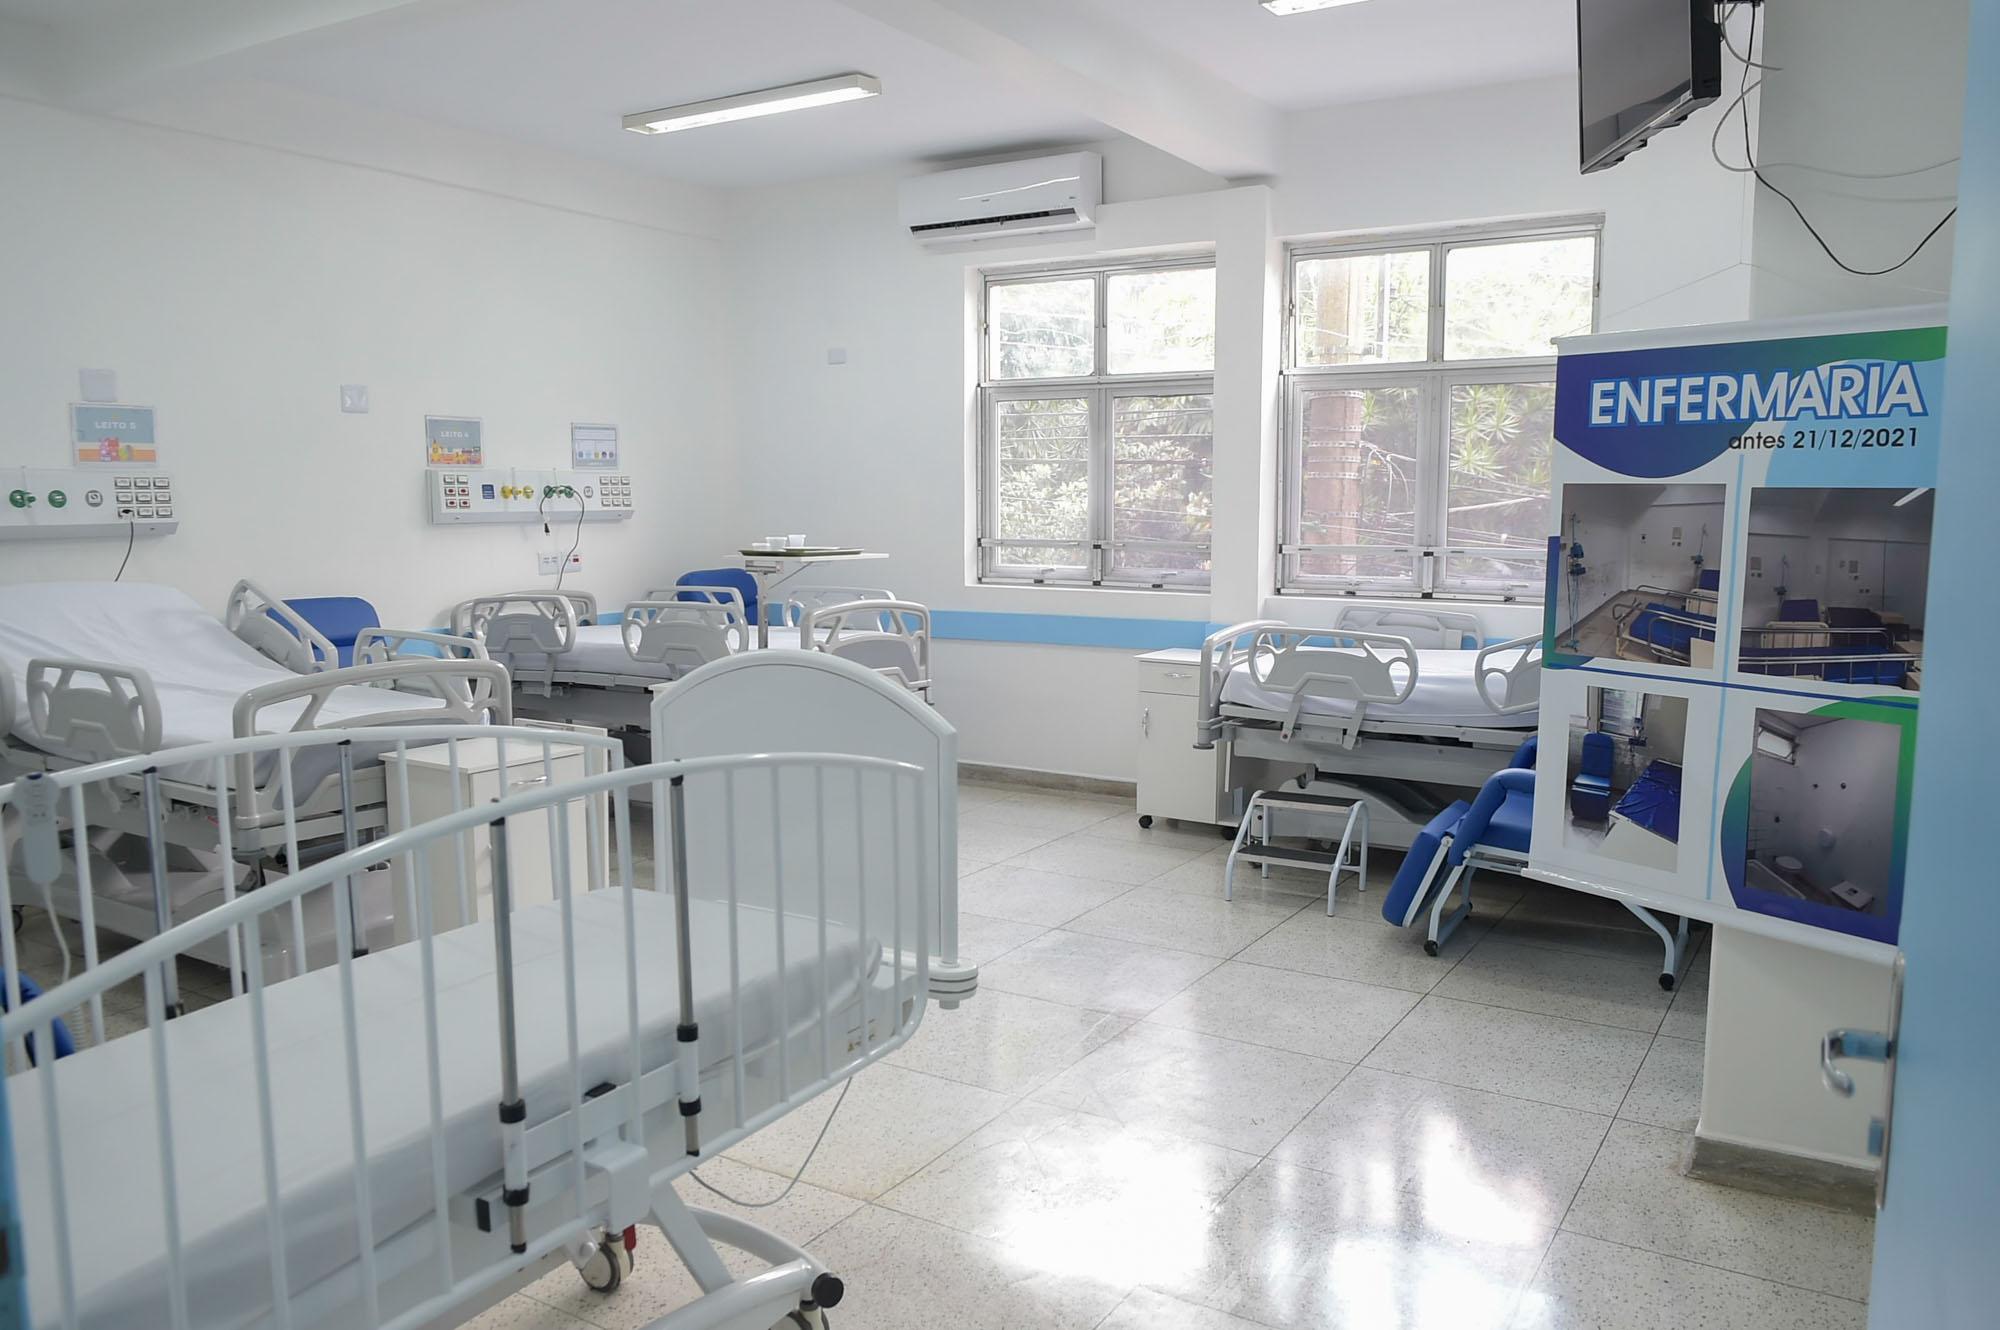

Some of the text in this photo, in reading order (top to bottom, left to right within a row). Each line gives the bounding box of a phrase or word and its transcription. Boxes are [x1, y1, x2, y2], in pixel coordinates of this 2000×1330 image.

[1588, 361, 1929, 427] ENFERMARIA
[95, 421, 127, 430] LEITO
[1728, 427, 1918, 451] antes 21/12/2021
